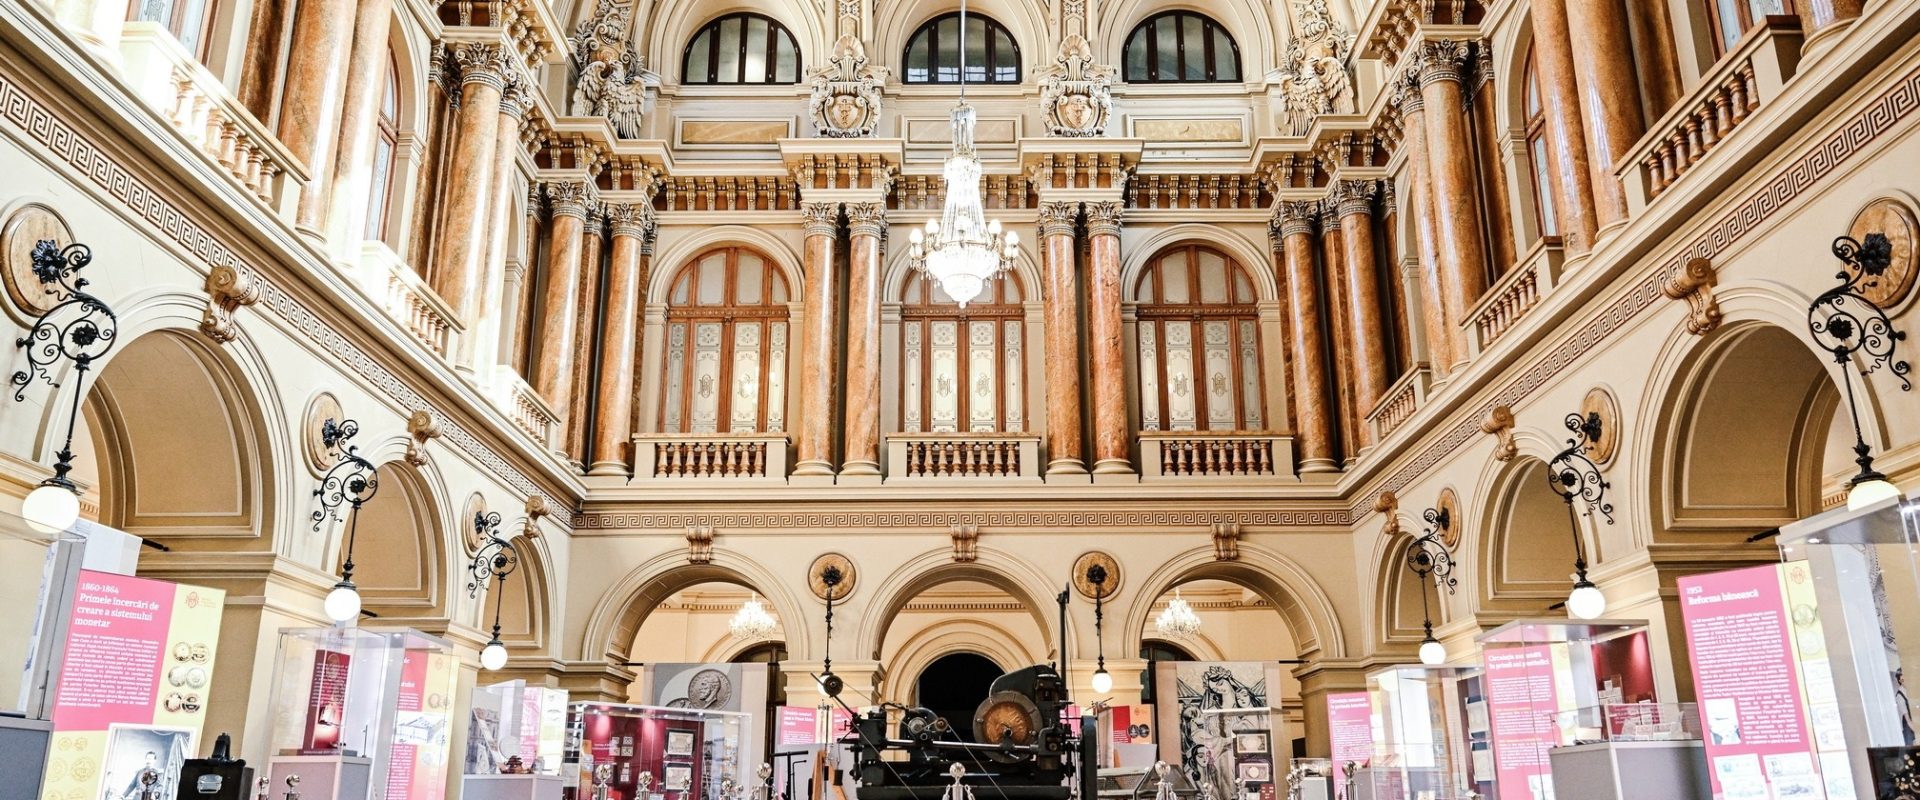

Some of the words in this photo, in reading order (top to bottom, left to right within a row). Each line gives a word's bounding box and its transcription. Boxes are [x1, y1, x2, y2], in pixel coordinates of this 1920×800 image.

[81, 582, 119, 594] 1860-1864
[79, 593, 112, 605] Primele
[112, 596, 148, 609] încercări
[149, 601, 160, 610] de
[76, 606, 104, 616] creare
[111, 609, 153, 621] sistemului
[74, 617, 111, 628] monetar
